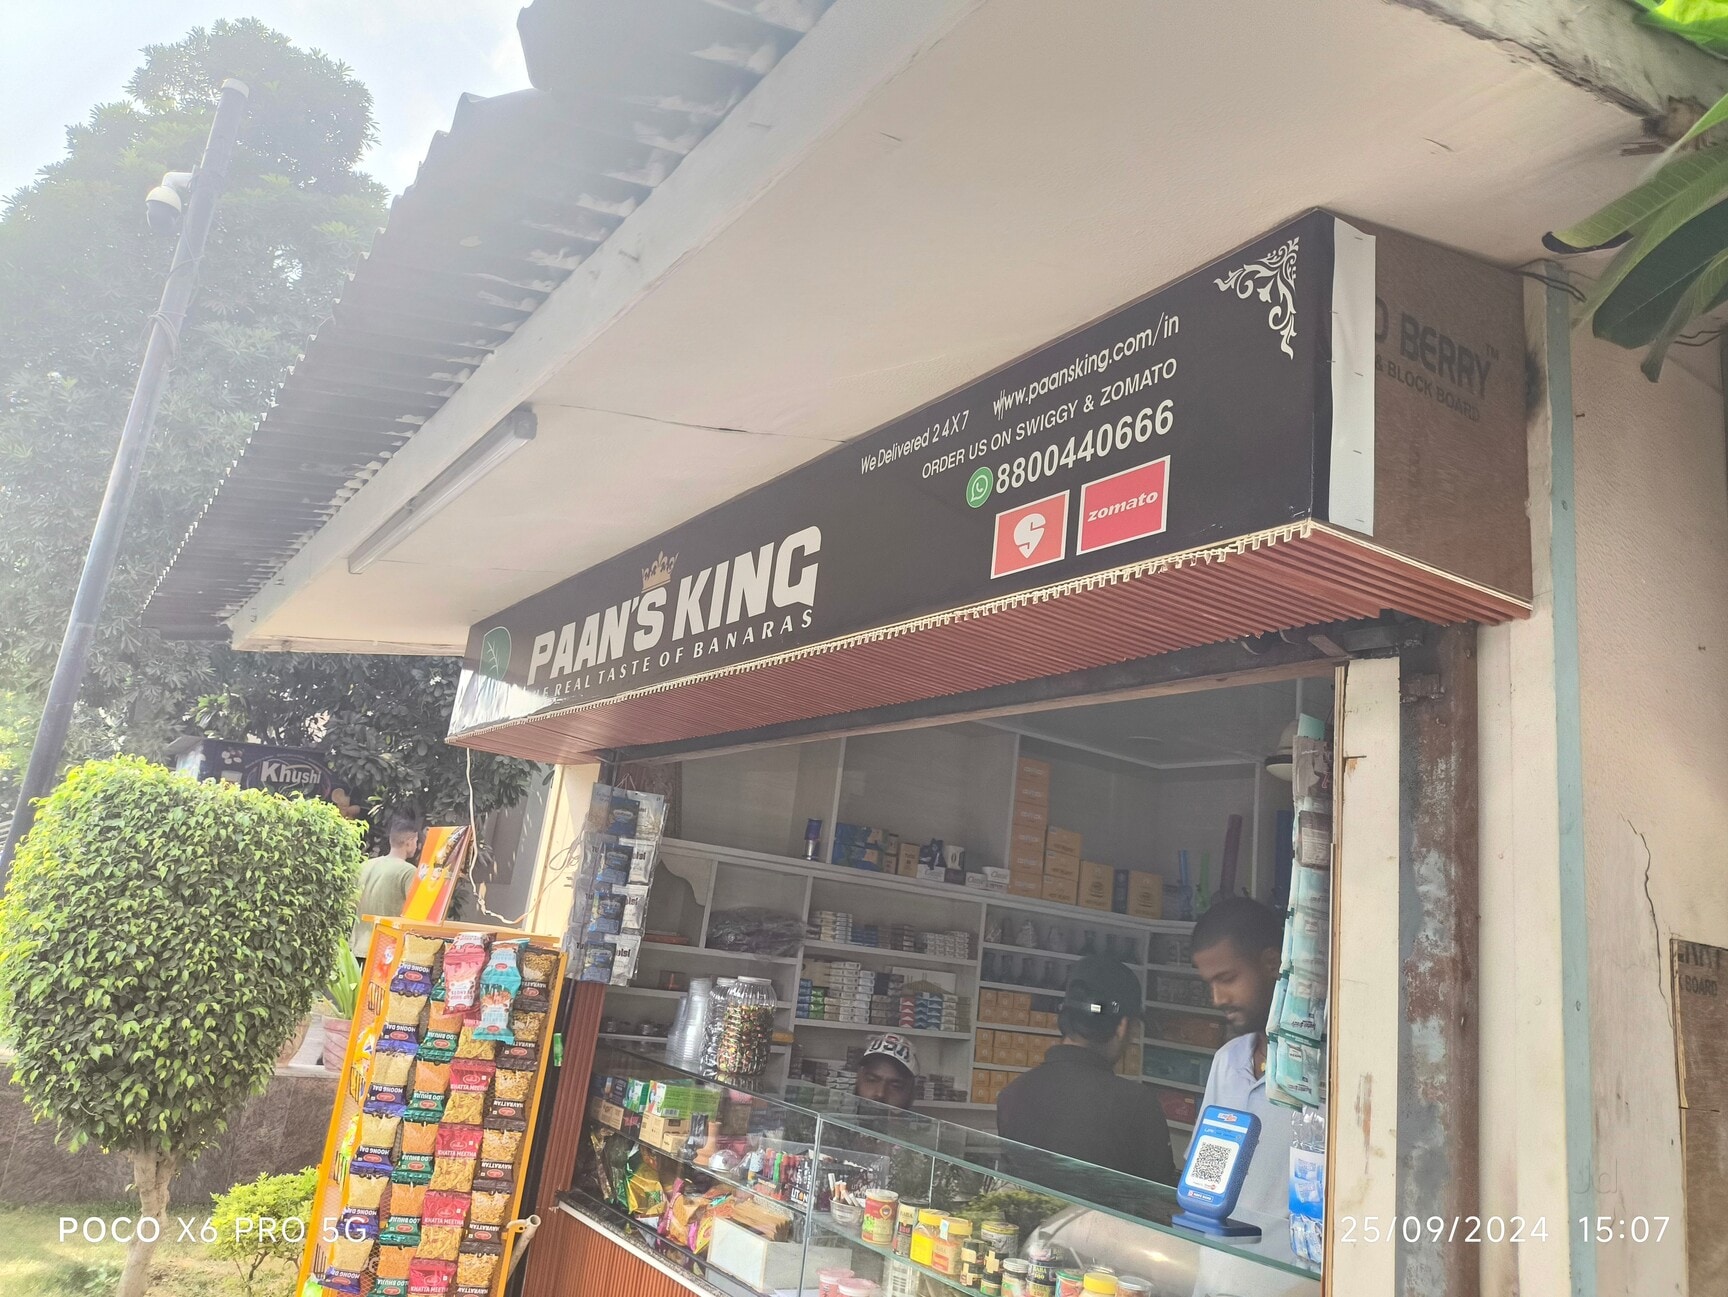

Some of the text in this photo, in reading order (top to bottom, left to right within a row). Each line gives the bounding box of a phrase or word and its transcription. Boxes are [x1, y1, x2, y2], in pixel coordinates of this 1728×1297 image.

[1400, 311, 1491, 400] BERRY
[1387, 360, 1433, 398] BLOCK
[1435, 385, 1480, 423] BOARD
[922, 358, 1178, 479] ORDER US ON SWIGGY & ZOMATO
[860, 454, 877, 475] We
[877, 427, 930, 468] Delivered
[996, 399, 1175, 494] 8800440666
[1086, 490, 1159, 523] zomato
[527, 525, 822, 686] PAAN'S KING
[554, 676, 591, 697] REAL
[598, 657, 650, 685] TASTE
[659, 646, 685, 668] OF
[693, 608, 814, 660] BANARAS
[260, 760, 322, 784] Khushi
[493, 1100, 524, 1108] NAVRATTAN
[438, 1150, 455, 1158] KHATTA
[482, 1162, 512, 1170] NAVRATTAN
[424, 1217, 444, 1225] KHATTA
[470, 1224, 500, 1232] NAVRATTAN
[457, 1287, 488, 1295] NAVRATTAN
